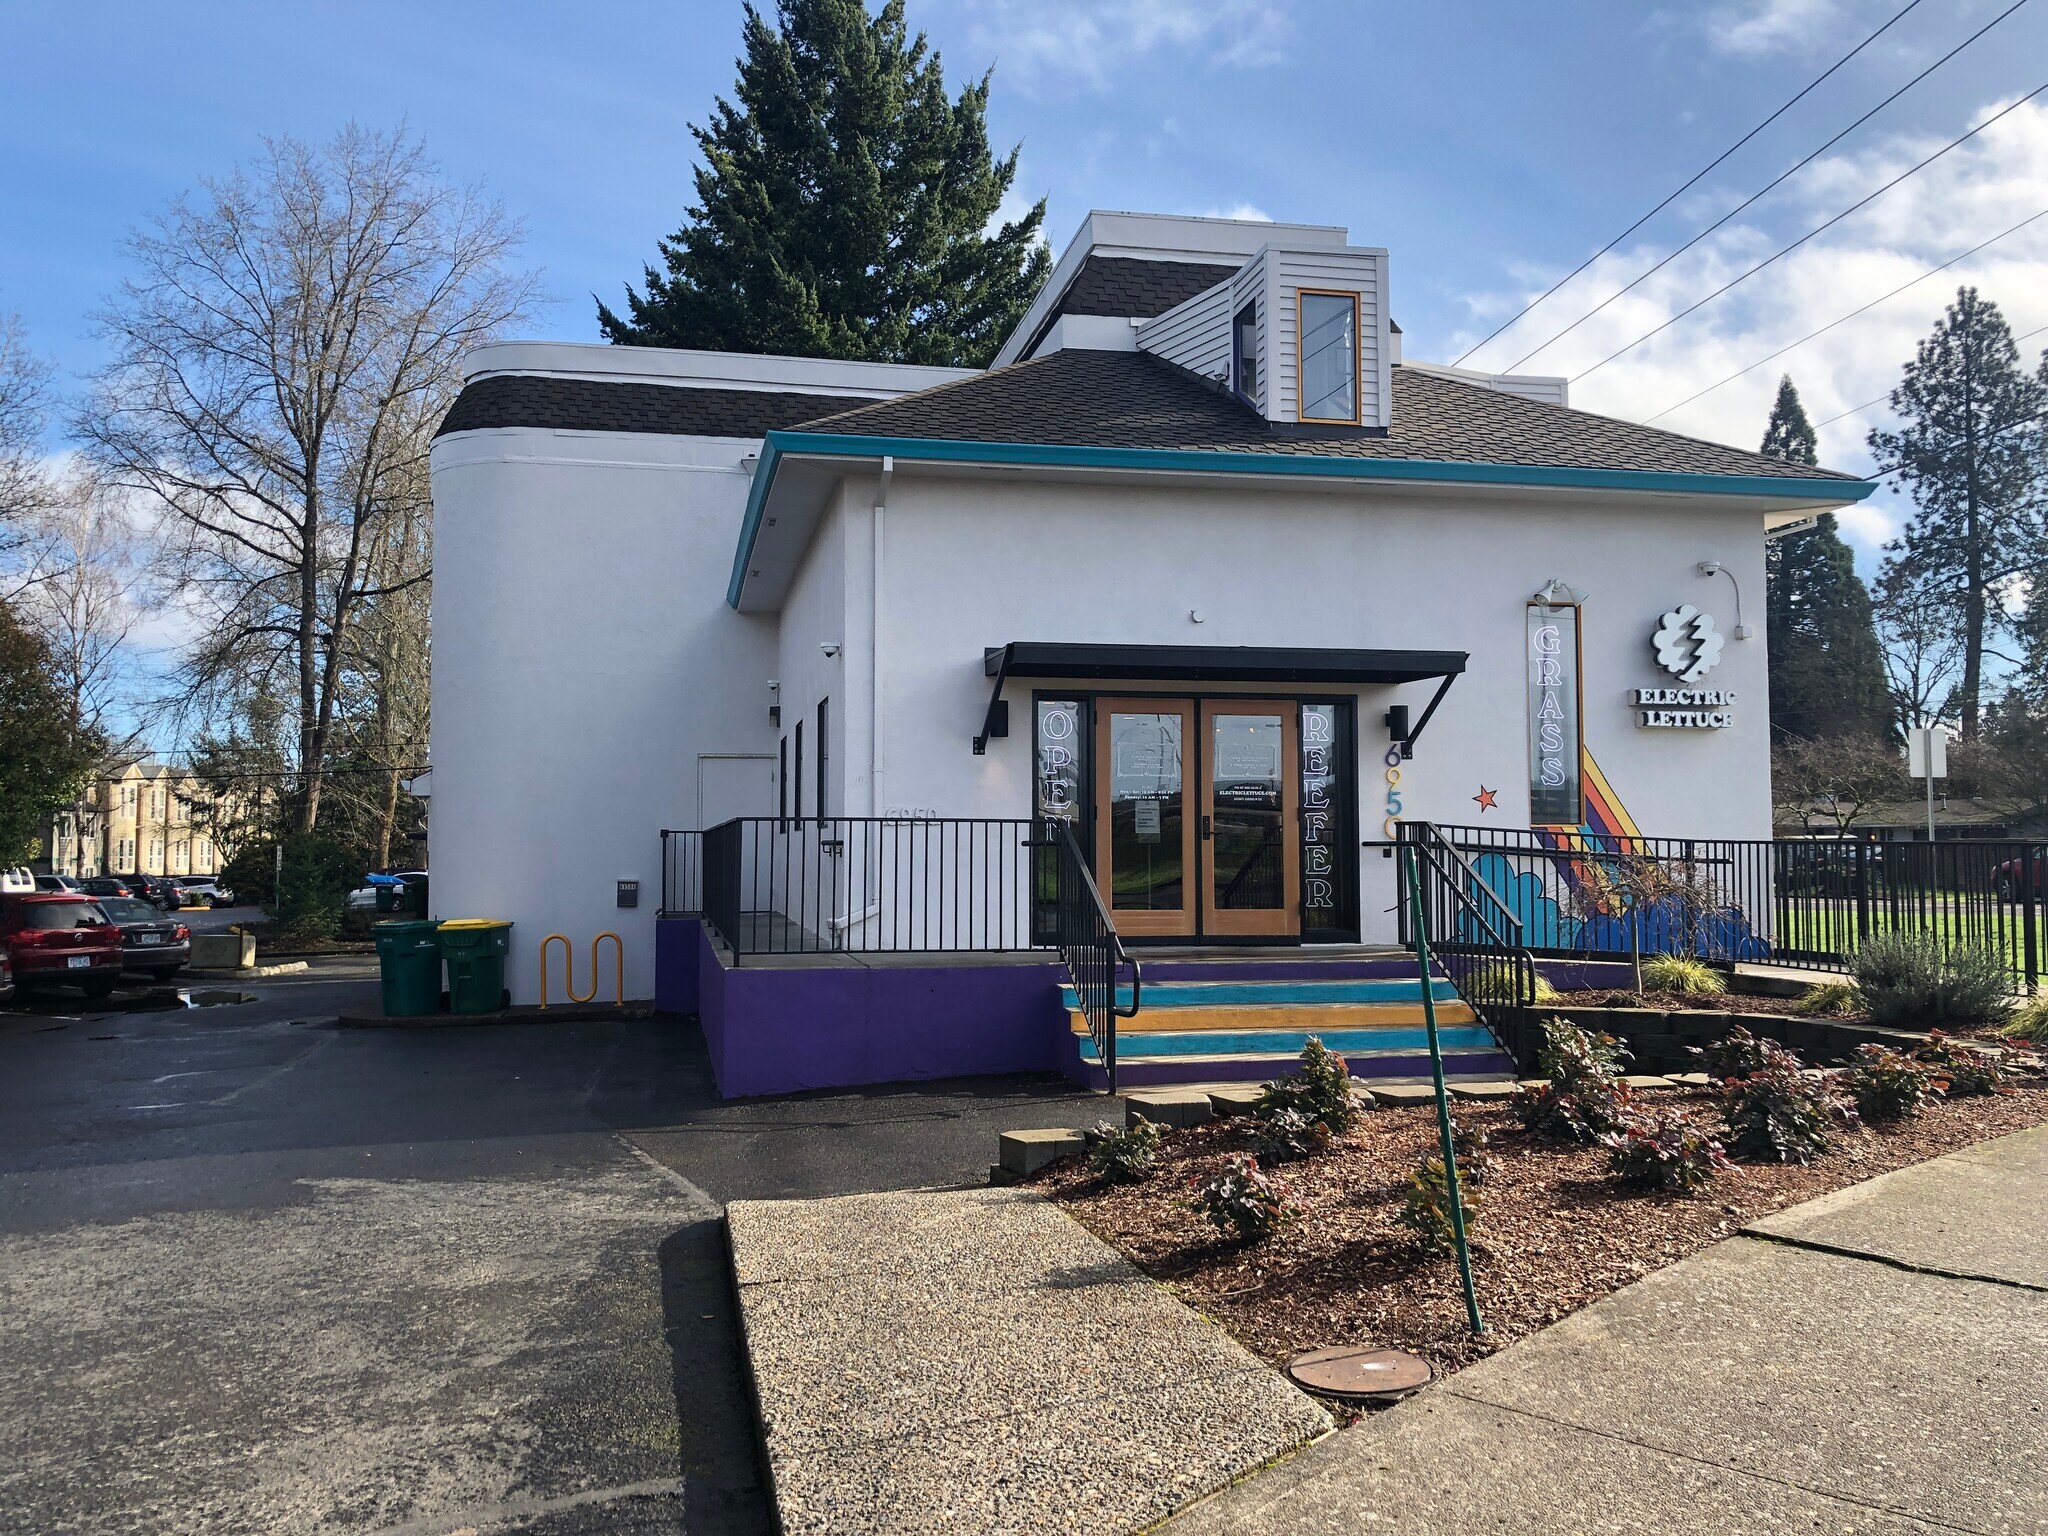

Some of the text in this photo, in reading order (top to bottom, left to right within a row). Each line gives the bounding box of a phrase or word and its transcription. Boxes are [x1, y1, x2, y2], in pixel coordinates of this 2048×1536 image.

[1533, 625, 1565, 787] GRASS
[1638, 688, 1738, 706] ELECTRIC
[1645, 710, 1734, 728] LETTUCE
[1302, 712, 1334, 908] REEFER
